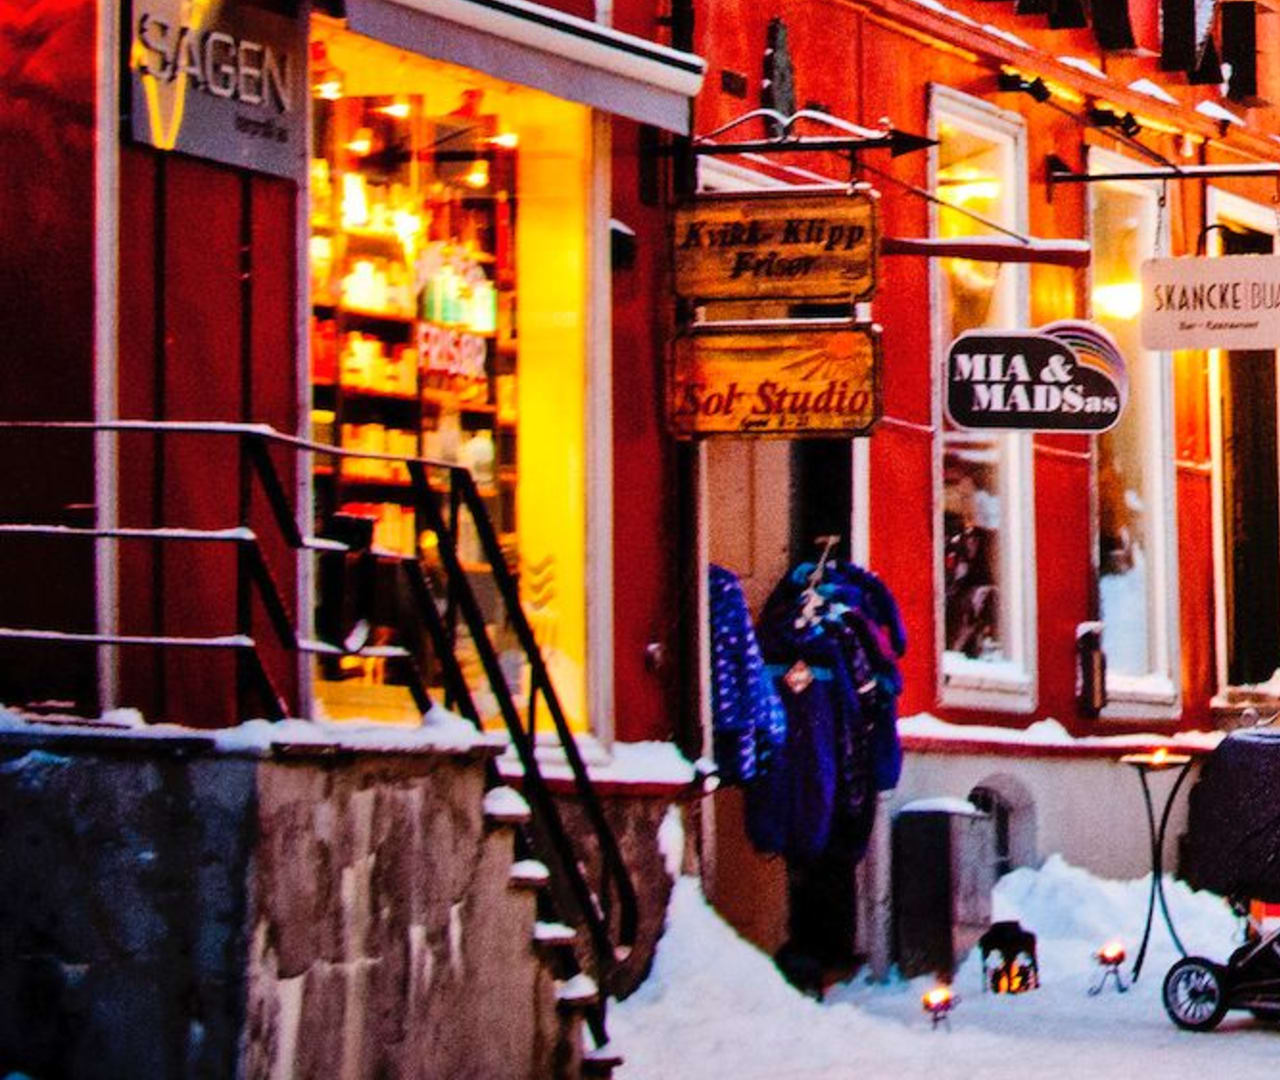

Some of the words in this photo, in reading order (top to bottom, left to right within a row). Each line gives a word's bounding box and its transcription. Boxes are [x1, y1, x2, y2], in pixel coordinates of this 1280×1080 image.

[1154, 283, 1241, 311] SKANCKE
[953, 354, 1032, 382] MIA
[1040, 354, 1074, 383] &
[751, 379, 869, 415] Studio
